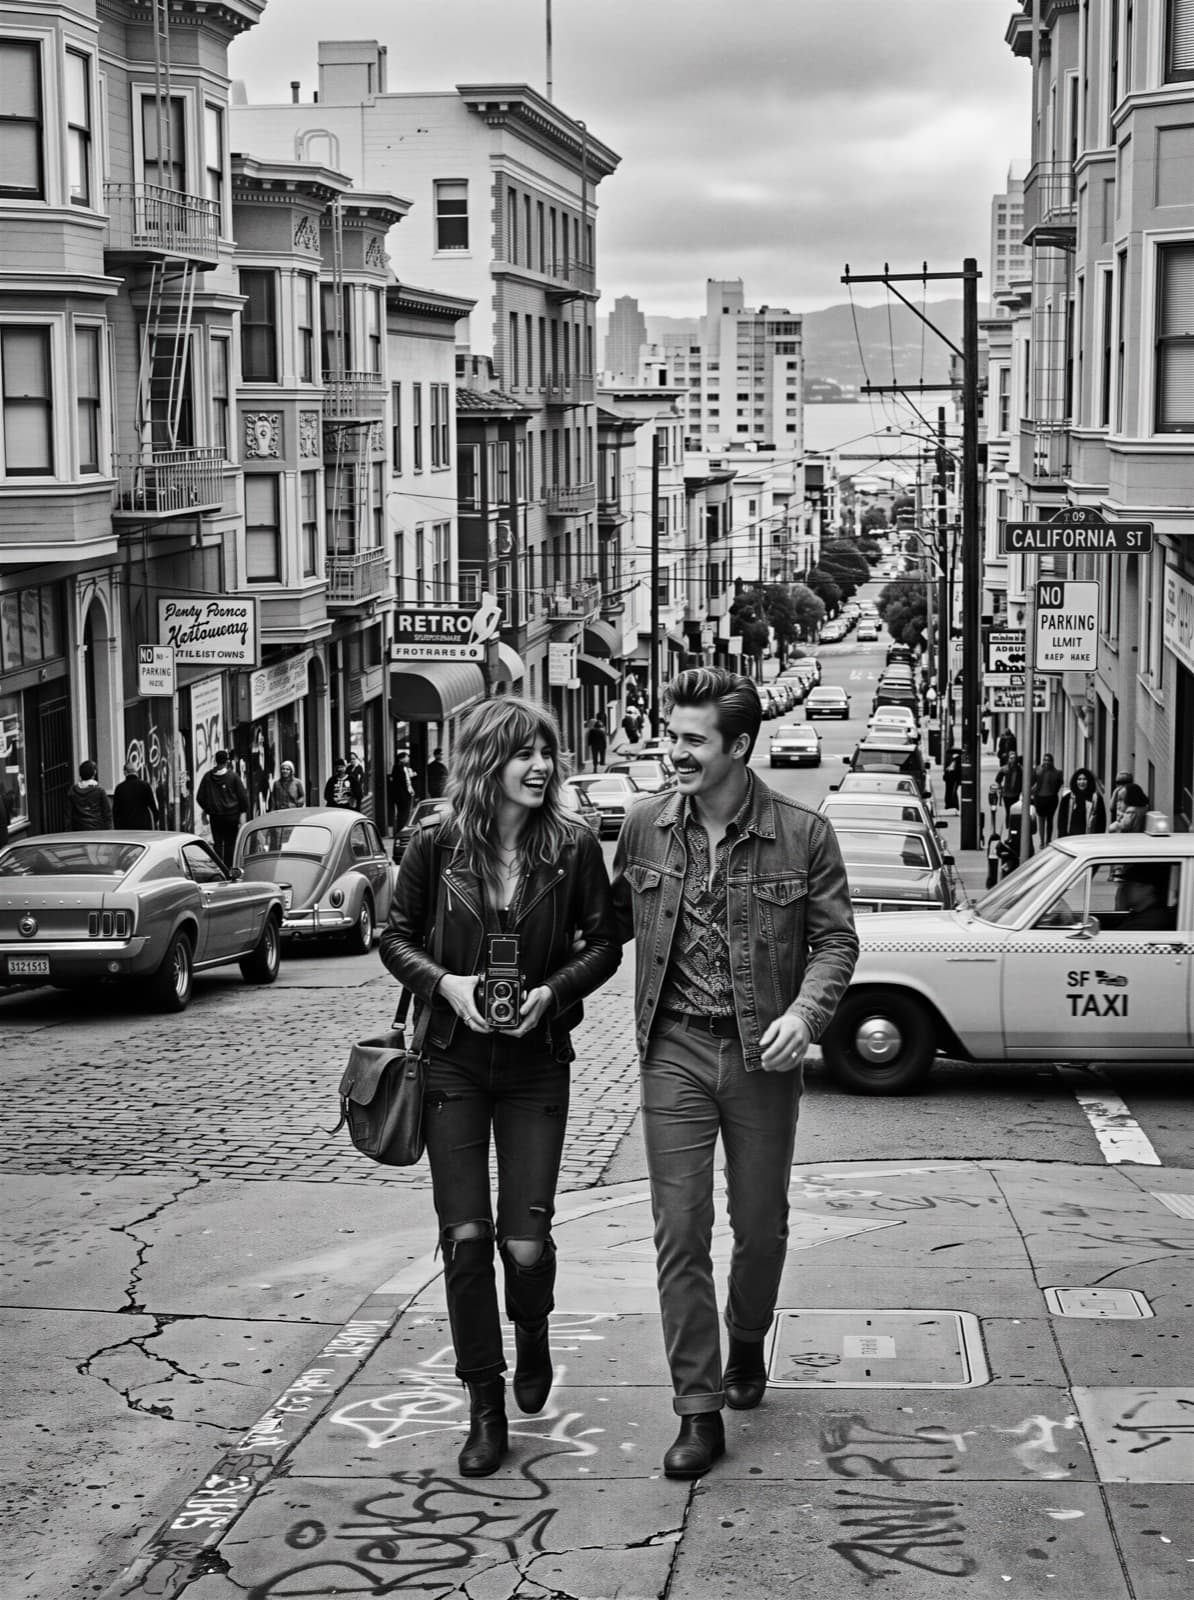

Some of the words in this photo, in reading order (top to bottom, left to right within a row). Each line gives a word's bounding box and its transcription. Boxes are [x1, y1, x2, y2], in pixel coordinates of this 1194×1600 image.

[1072, 511, 1086, 522] 09
[1012, 529, 1117, 547] CALIFORNIA
[1126, 531, 1144, 547] ST
[1040, 586, 1061, 606] NO
[398, 615, 472, 633] RETRO
[1040, 614, 1096, 631] PARKING
[140, 648, 153, 662] NO
[141, 667, 172, 677] PARKING
[1067, 970, 1091, 987] SF
[1065, 994, 1129, 1017] TAXI
